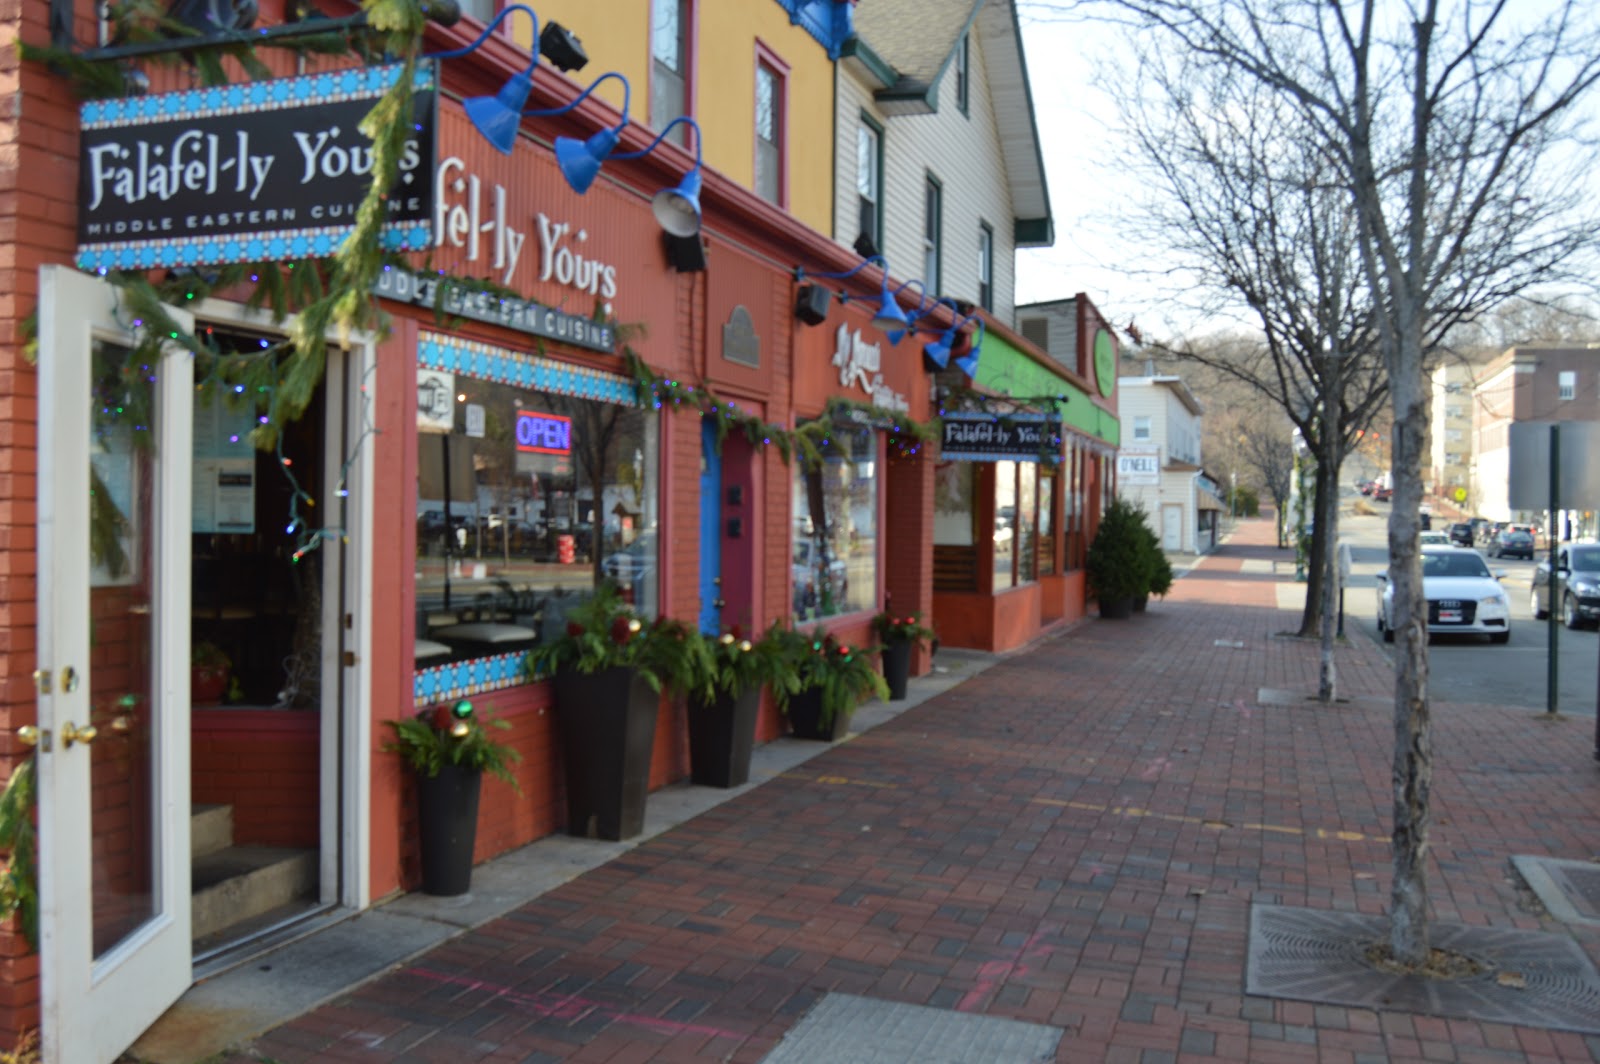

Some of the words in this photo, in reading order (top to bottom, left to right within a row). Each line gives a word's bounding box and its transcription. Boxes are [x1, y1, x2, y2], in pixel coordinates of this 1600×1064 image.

[88, 130, 275, 211] Falafel-ly
[293, 125, 420, 184] Yous
[88, 217, 173, 235] MIDDLE
[186, 207, 296, 228] EASTERN
[311, 197, 420, 219] CUINE
[435, 156, 525, 286] fel-ly
[536, 212, 617, 300] Yours
[450, 286, 538, 328] EASERN
[544, 312, 611, 348] CUISINE
[516, 415, 571, 450] OPEN
[945, 422, 1012, 446] Falafel-ly
